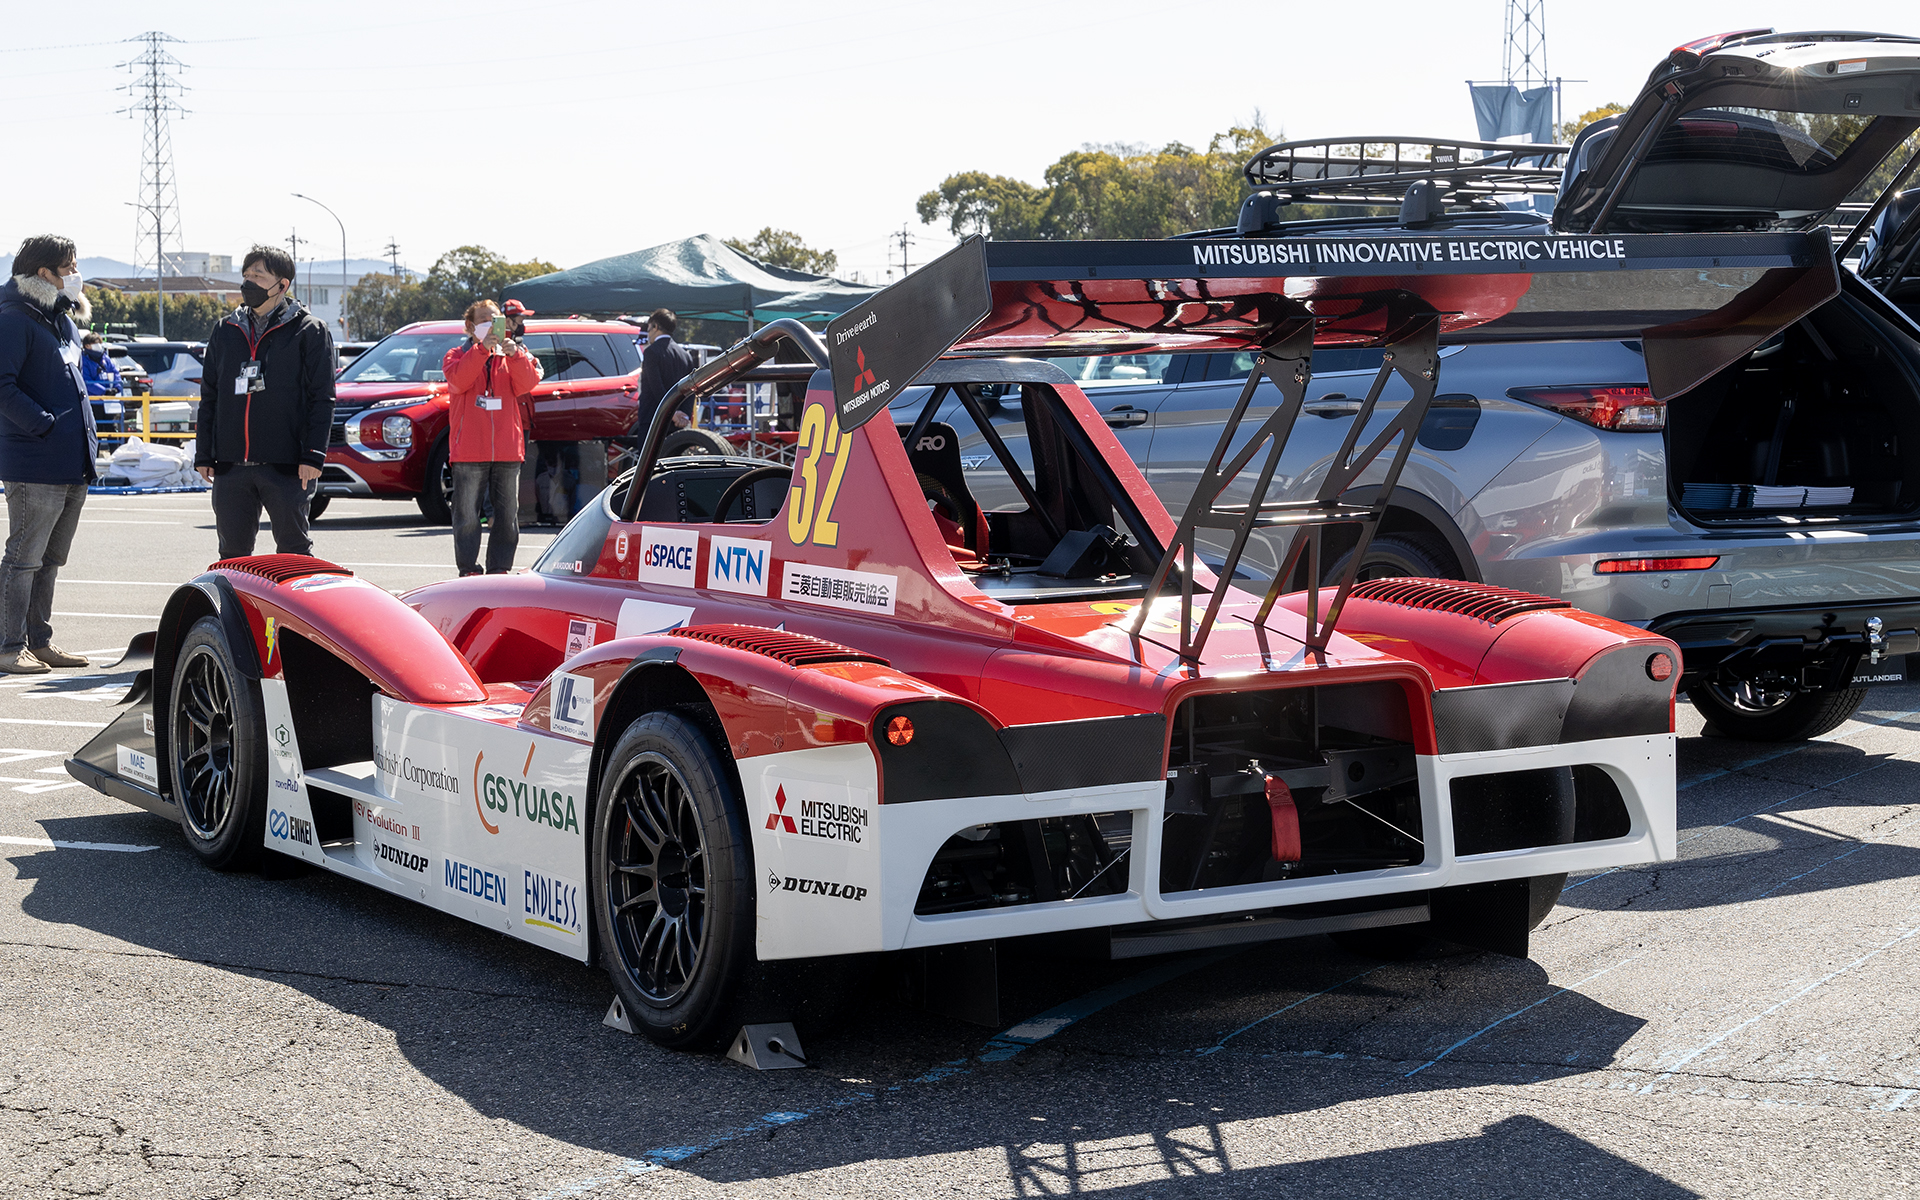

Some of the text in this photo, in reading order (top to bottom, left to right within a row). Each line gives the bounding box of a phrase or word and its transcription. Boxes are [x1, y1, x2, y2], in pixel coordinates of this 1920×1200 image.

[1435, 155, 1454, 163] THULE
[1193, 239, 1625, 265] MITSUBISHI INNOVATIVE ELECTRIC VEHICLE
[835, 310, 878, 346] Drive@earth
[843, 379, 891, 414] MITSUBISHI MOTORS
[788, 402, 853, 549] 32
[644, 544, 693, 570] dSPACE
[715, 546, 763, 586] NTN
[789, 572, 889, 607] 三菱自動車販売協会
[130, 752, 146, 770] MAE
[403, 756, 460, 794] Corporation
[367, 808, 408, 837] Evolution
[412, 825, 421, 841] III
[801, 799, 868, 827] MITSUBISHI
[289, 816, 313, 846] ENKEI
[801, 818, 862, 843] ELECTRIC
[380, 843, 429, 873] DUNLOP
[445, 858, 506, 906] MEIDEN
[782, 876, 868, 902] DUNLOP
[524, 870, 578, 928] ENDLESS
